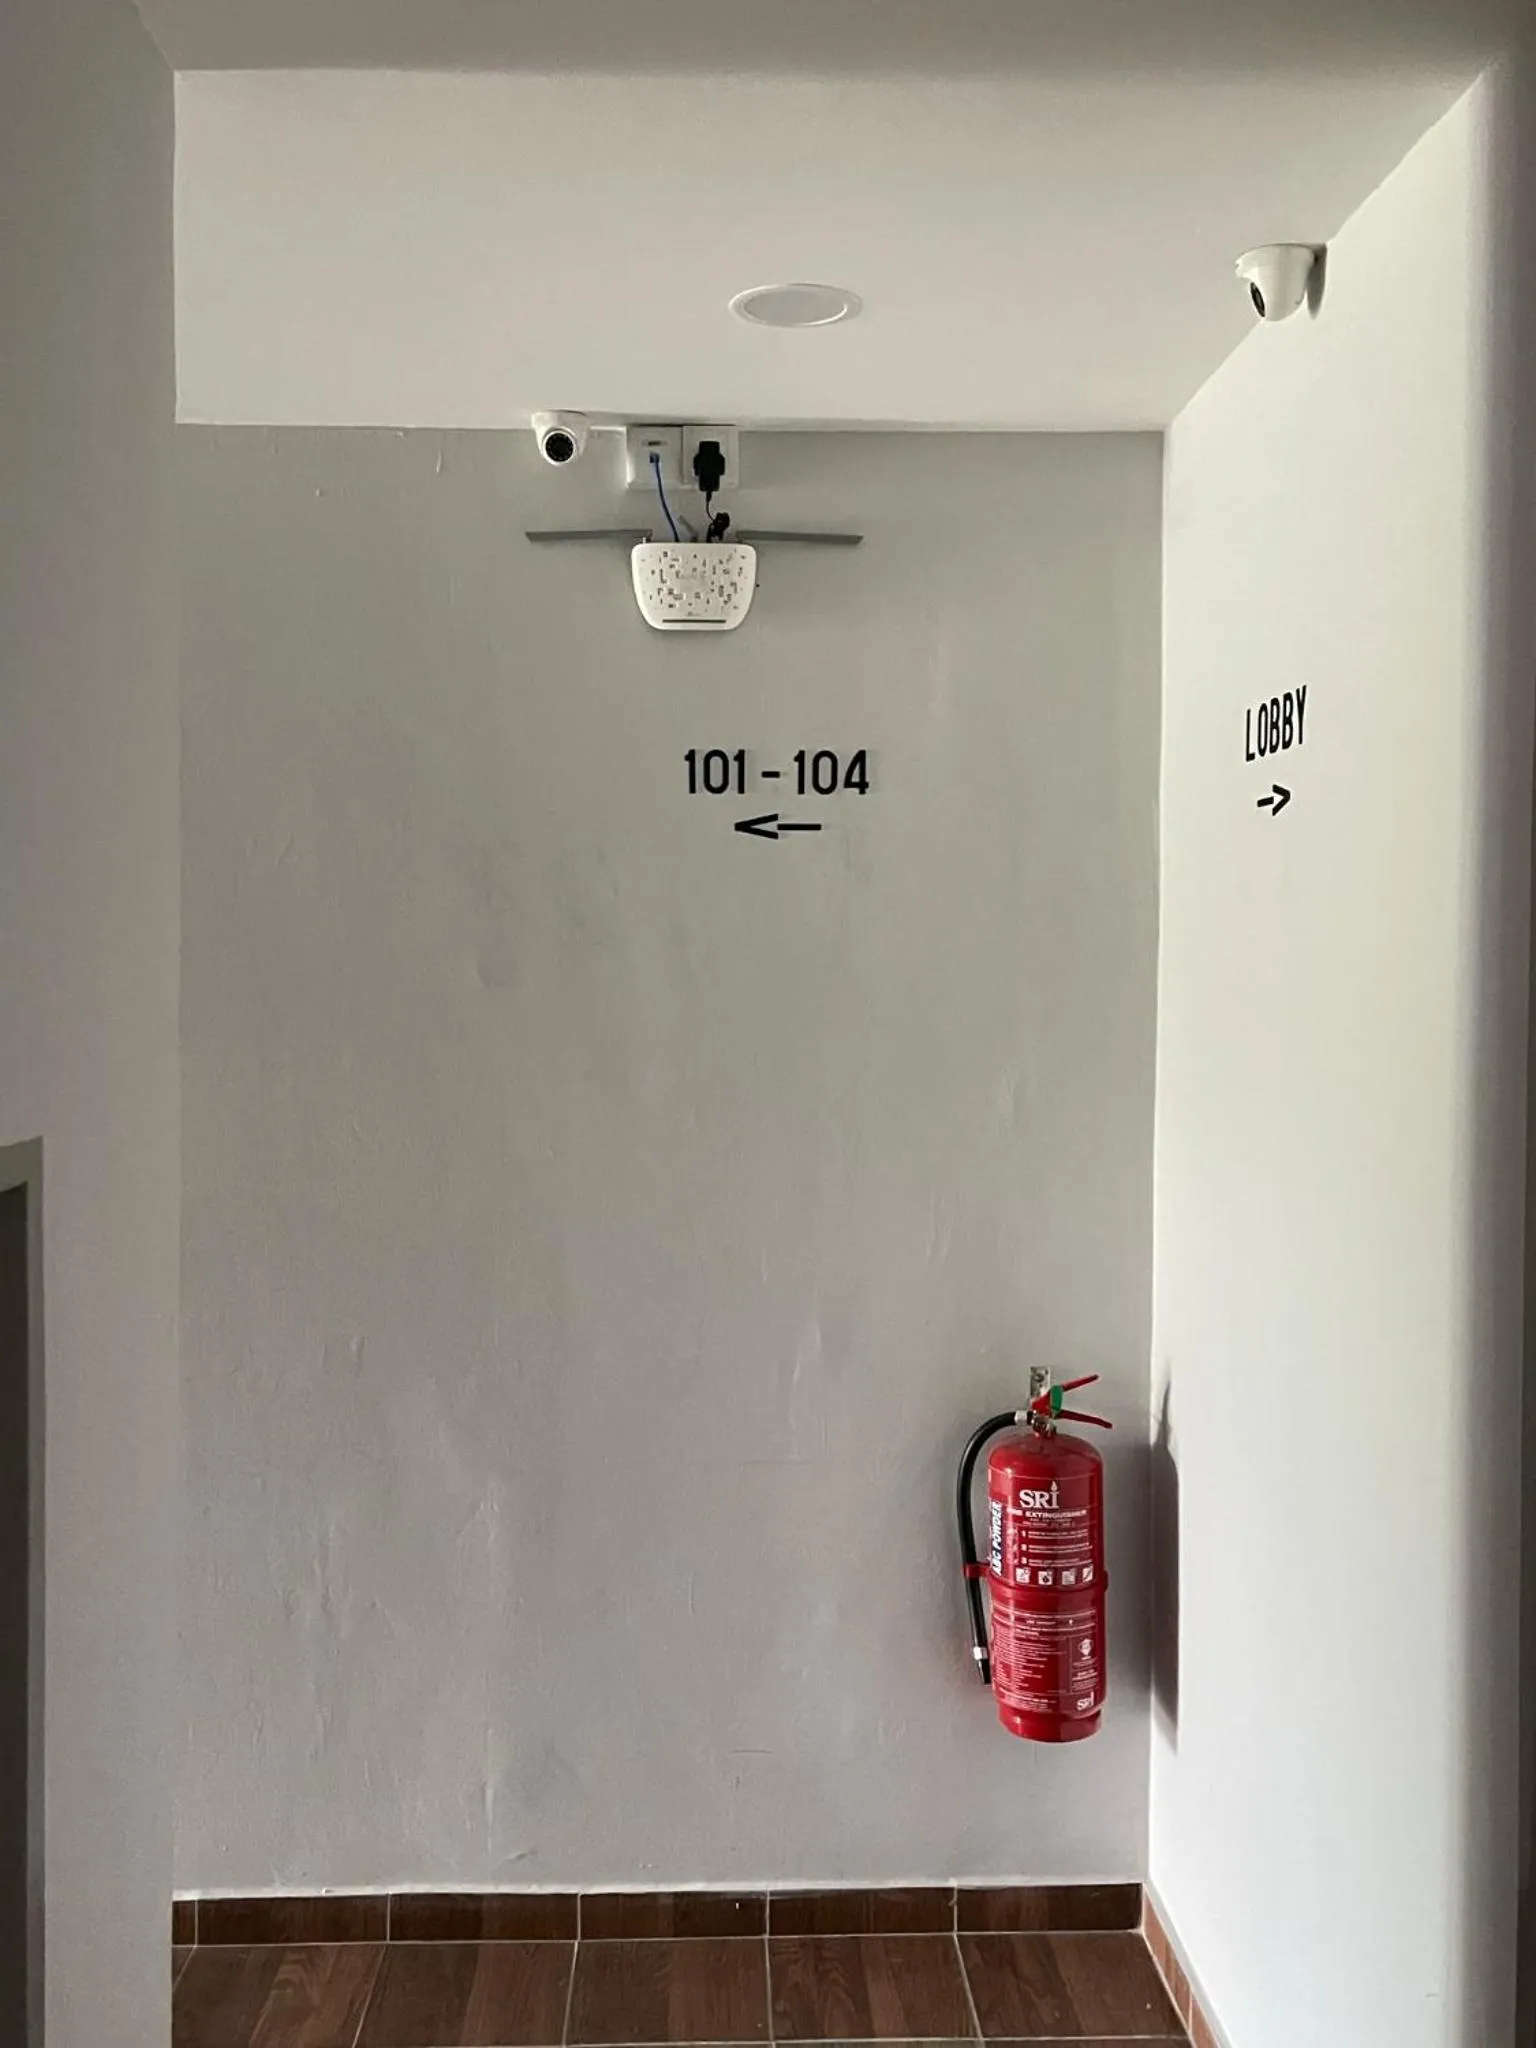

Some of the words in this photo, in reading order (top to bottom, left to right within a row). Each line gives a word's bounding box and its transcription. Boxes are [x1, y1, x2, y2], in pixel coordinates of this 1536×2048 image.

[1246, 684, 1307, 762] LOBBY
[684, 749, 746, 794] 101
[794, 749, 869, 795] 104
[991, 1501, 1003, 1550] POWDER
